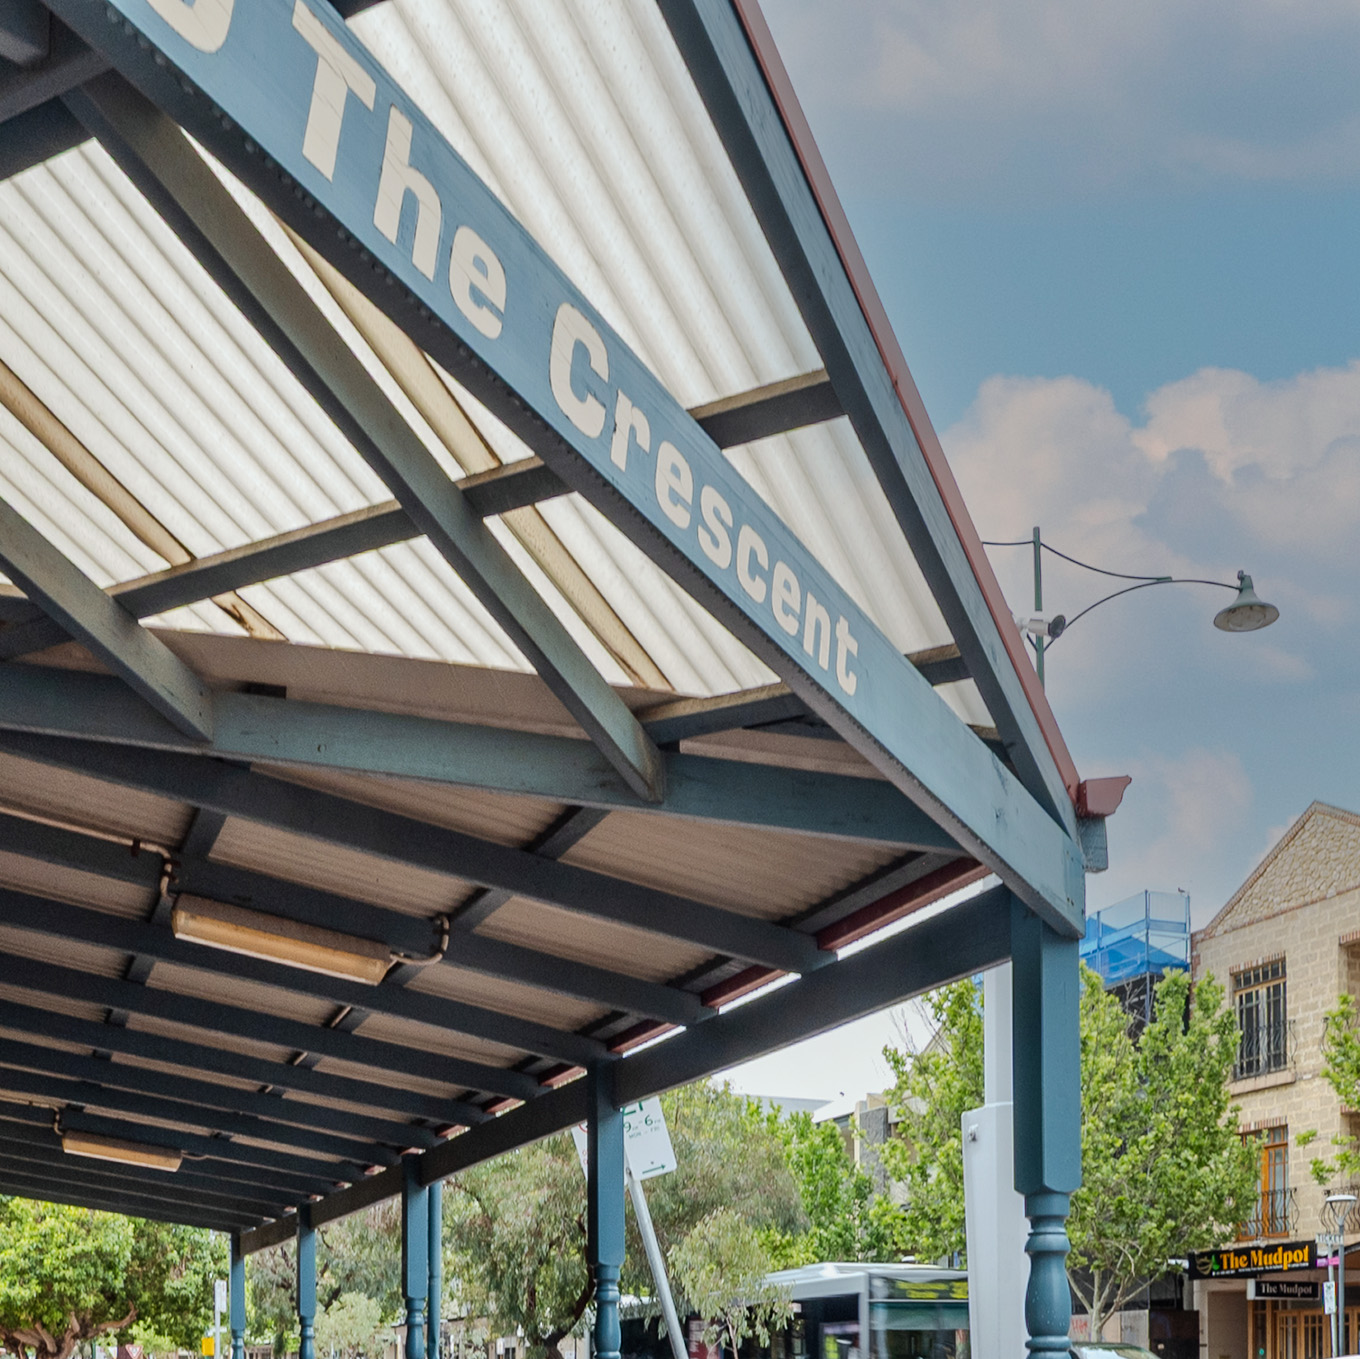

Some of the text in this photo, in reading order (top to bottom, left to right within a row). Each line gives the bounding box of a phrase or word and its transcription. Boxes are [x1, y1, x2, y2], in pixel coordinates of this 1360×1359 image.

[292, 0, 858, 697] The Crescent
[1220, 1251, 1249, 1270] The
[1250, 1244, 1309, 1270] Mudpot
[1261, 1283, 1313, 1298] The Mudpot
